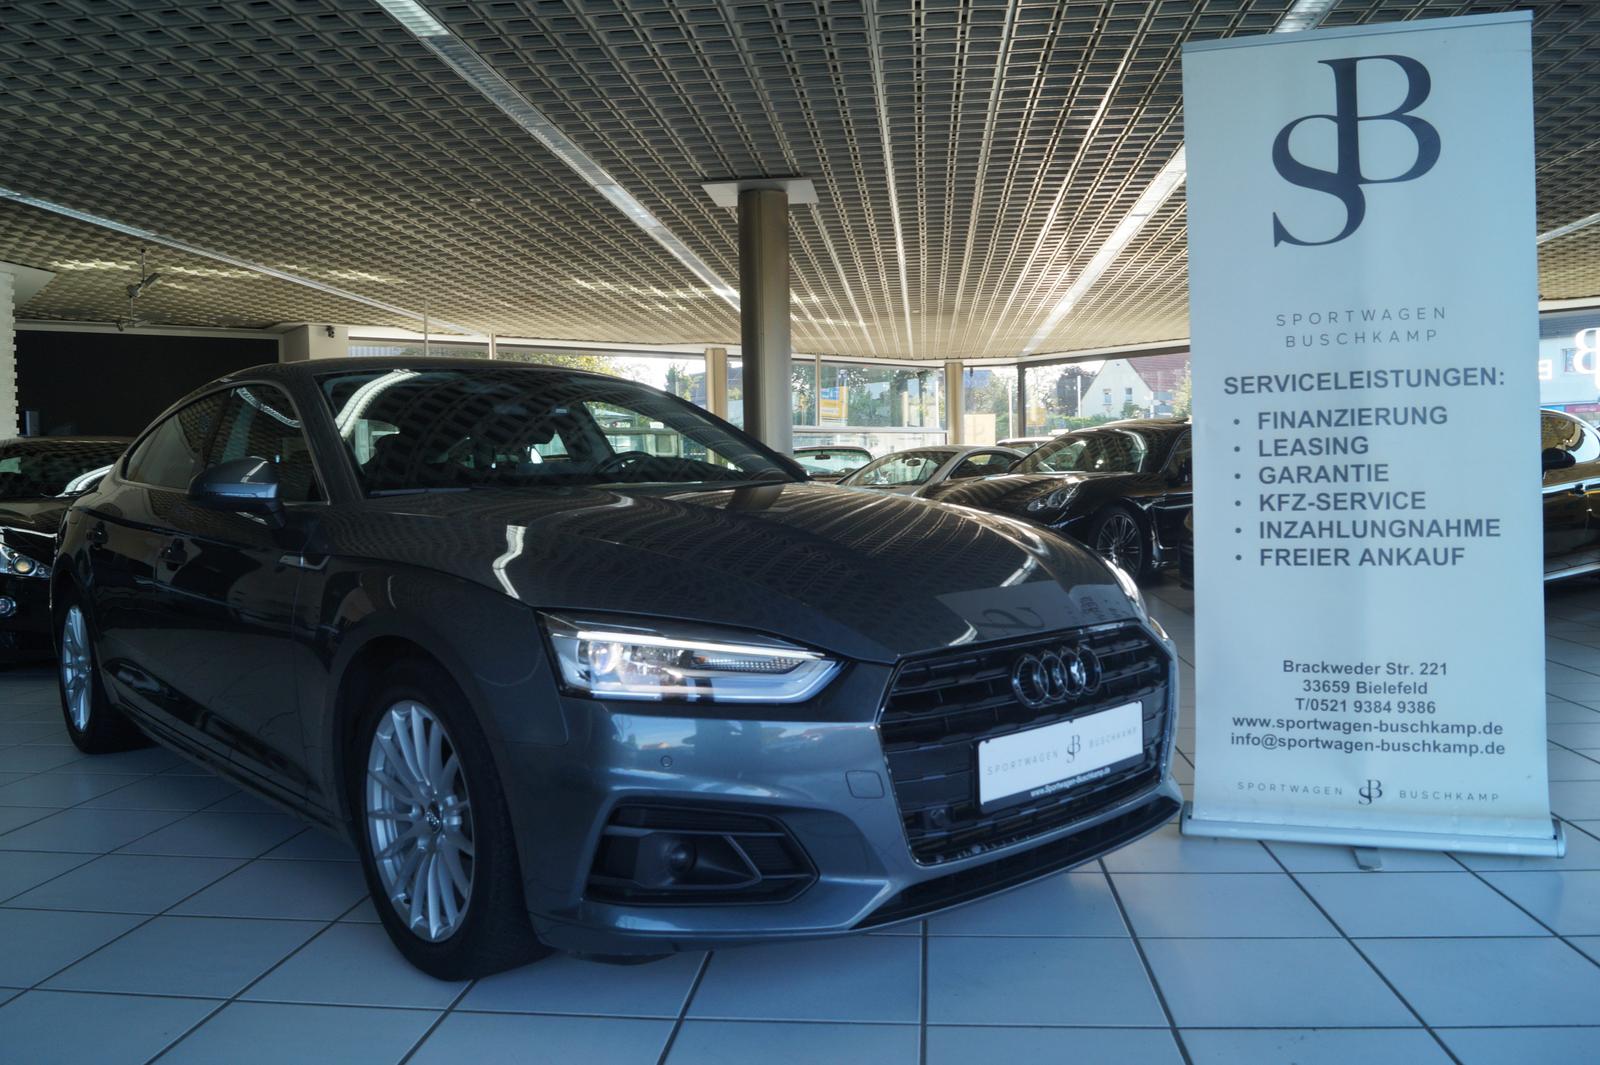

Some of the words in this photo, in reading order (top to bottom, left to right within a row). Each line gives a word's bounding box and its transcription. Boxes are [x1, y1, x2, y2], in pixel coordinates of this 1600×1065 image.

[1276, 306, 1447, 327] SPORTWAGEN
[1285, 328, 1438, 348] BUSCHKAMP
[1223, 366, 1505, 395] SERVICELEISTUNGEN:
[1257, 405, 1448, 430] FINANZIERUNG
[1258, 435, 1369, 458] LEASING
[1258, 463, 1390, 485] GARANTIE
[1259, 490, 1427, 512] KFZ-SERVICE
[1259, 518, 1502, 540] INZAHLUNGNAHME
[1259, 547, 1351, 567] FREIER
[1358, 546, 1466, 567] ANKAUF
[1282, 659, 1382, 676] Brackweder
[1385, 661, 1415, 676] Str.
[1419, 661, 1448, 676] 221
[1302, 678, 1351, 694] 33659
[1355, 680, 1428, 696] Bielefeld
[1294, 696, 1347, 713] T/0521
[1352, 699, 1392, 714] 9384
[1396, 700, 1437, 715] 9386
[1231, 716, 1504, 737] www.sportwagen-buschkamp.de
[1230, 732, 1506, 757] info@sportwagen-buschkamp.de
[1237, 781, 1344, 796] SPORTWAGEN
[1398, 789, 1500, 802] BUSCHKAMP
